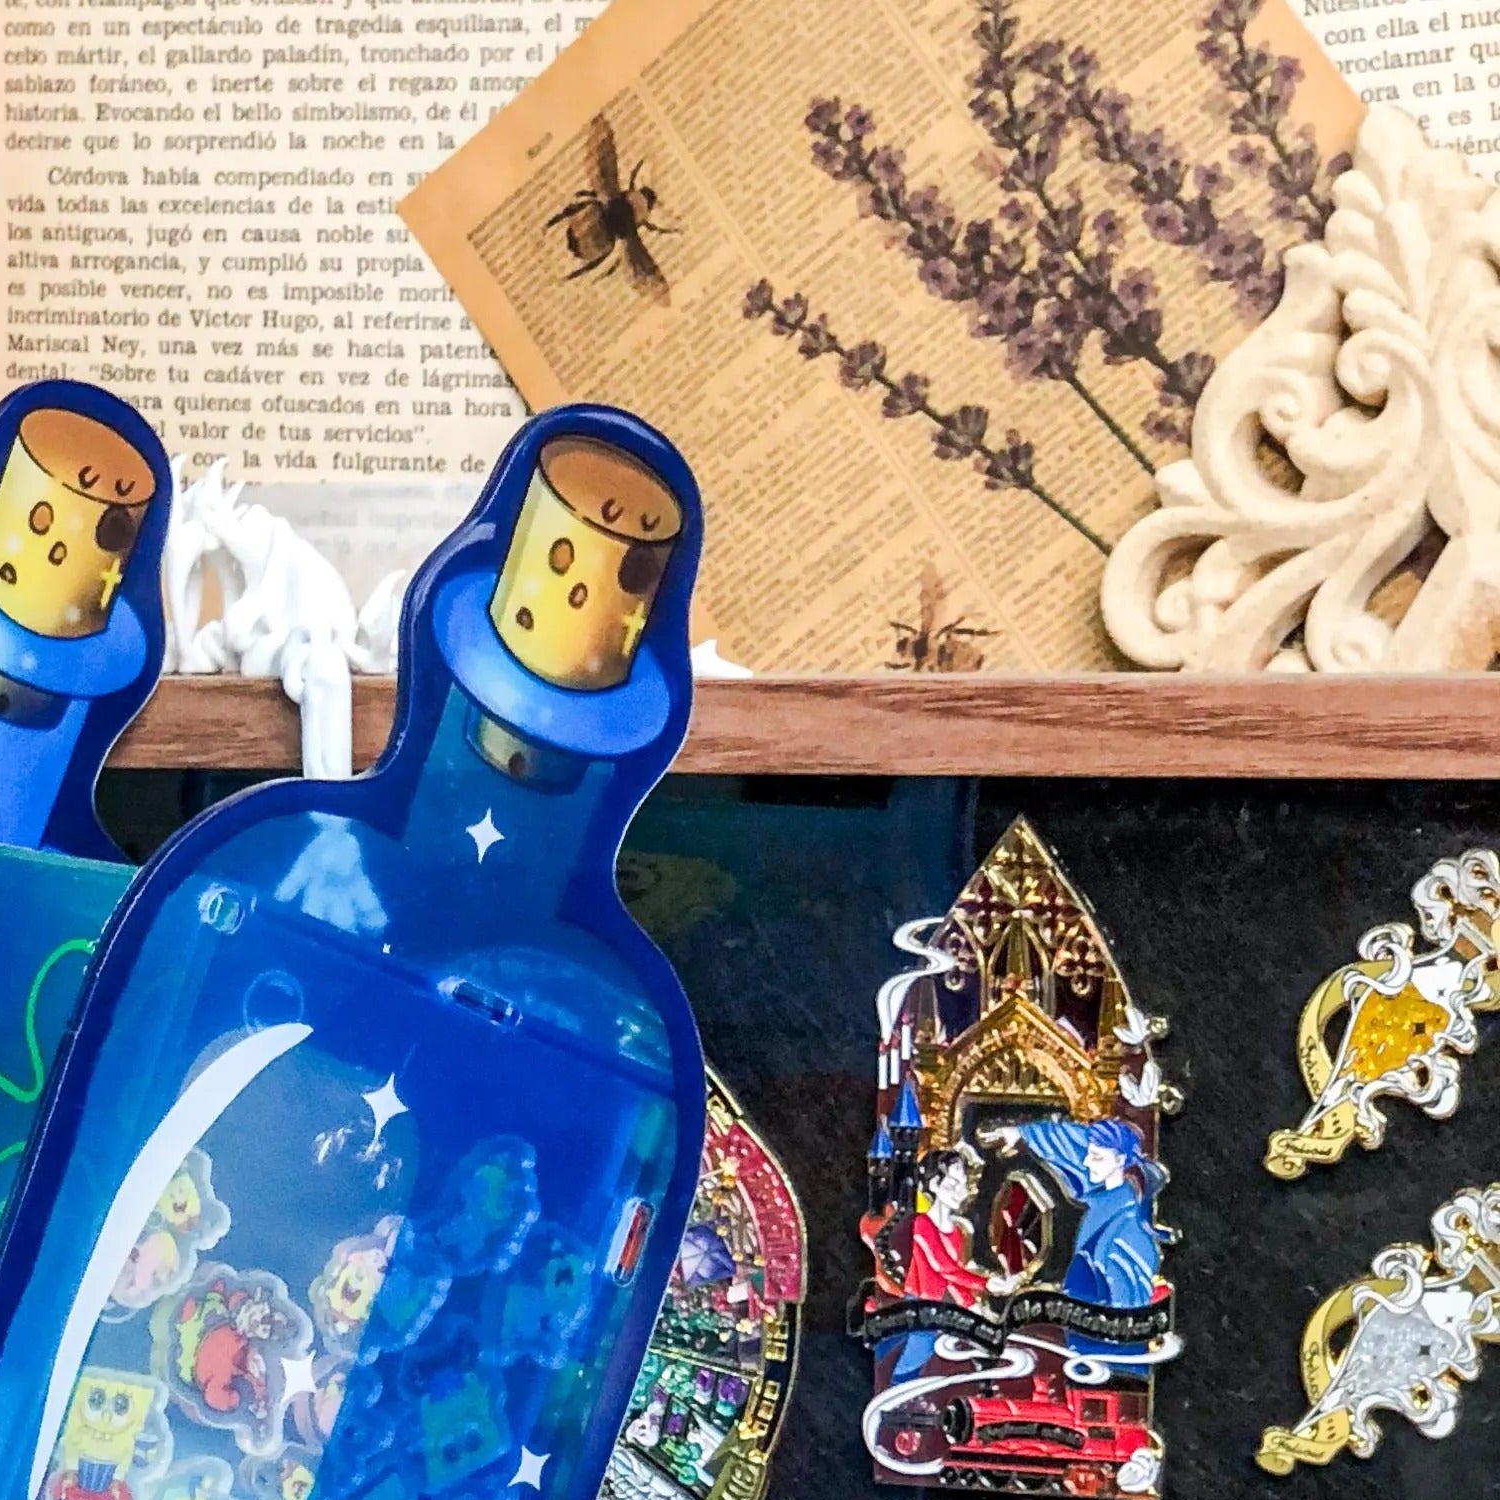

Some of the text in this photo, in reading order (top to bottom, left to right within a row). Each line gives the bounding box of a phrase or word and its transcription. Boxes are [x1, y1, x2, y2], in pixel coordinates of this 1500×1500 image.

[4, 22, 55, 37] como
[67, 21, 91, 36] en
[103, 21, 130, 36] un
[142, 16, 263, 40] espectáculo
[275, 16, 301, 34] de
[315, 15, 403, 39] tragedia
[544, 13, 561, 32] el
[1324, 11, 1450, 46] con ella el
[4, 47, 47, 64] cebo
[57, 47, 128, 67] mártir,
[138, 46, 155, 65] el
[166, 46, 252, 69] gallardo
[360, 44, 469, 63] tronchado
[480, 47, 515, 67] por
[525, 43, 543, 62] el
[4, 73, 458, 96] sablazo foráneo, inerte sobre el regazo
[1412, 79, 1442, 97] en
[1453, 73, 1475, 93] la
[96, 103, 195, 121] Evocando
[203, 103, 221, 122] el
[232, 103, 282, 121] bello
[292, 102, 417, 123] simbolismo,
[426, 102, 451, 120] de
[459, 102, 477, 121] él
[1447, 109, 1472, 126] es
[5, 131, 456, 155] decirse que lo sorprendió la noche en la
[47, 166, 129, 185] Córdova
[214, 167, 354, 191] compendiado
[368, 171, 393, 186] en
[7, 195, 345, 215] vida todas las excelencias de la
[7, 222, 409, 247] los antiguos, jugó en causa noble su
[7, 251, 424, 278] altiva arrogancia, cumplió su propia
[40, 280, 384, 305] posible vencer, no es imposible
[7, 307, 150, 326] incriminatorio
[157, 309, 181, 327] de
[263, 310, 324, 333] Hugo,
[333, 311, 353, 329] al
[364, 312, 451, 330] referirse
[8, 334, 89, 353] Mariscal
[102, 335, 146, 358] Ney,
[158, 340, 197, 355] una
[211, 341, 243, 356] vez
[256, 339, 299, 357] más
[203, 366, 285, 384] cadáver
[337, 371, 370, 386] vez
[385, 368, 409, 387] de
[174, 395, 512, 417] quienes ofuscados en una hora
[179, 421, 230, 440] valor
[241, 422, 266, 440] de
[279, 424, 312, 441] tus
[243, 450, 484, 474] la vida fulgurante de
